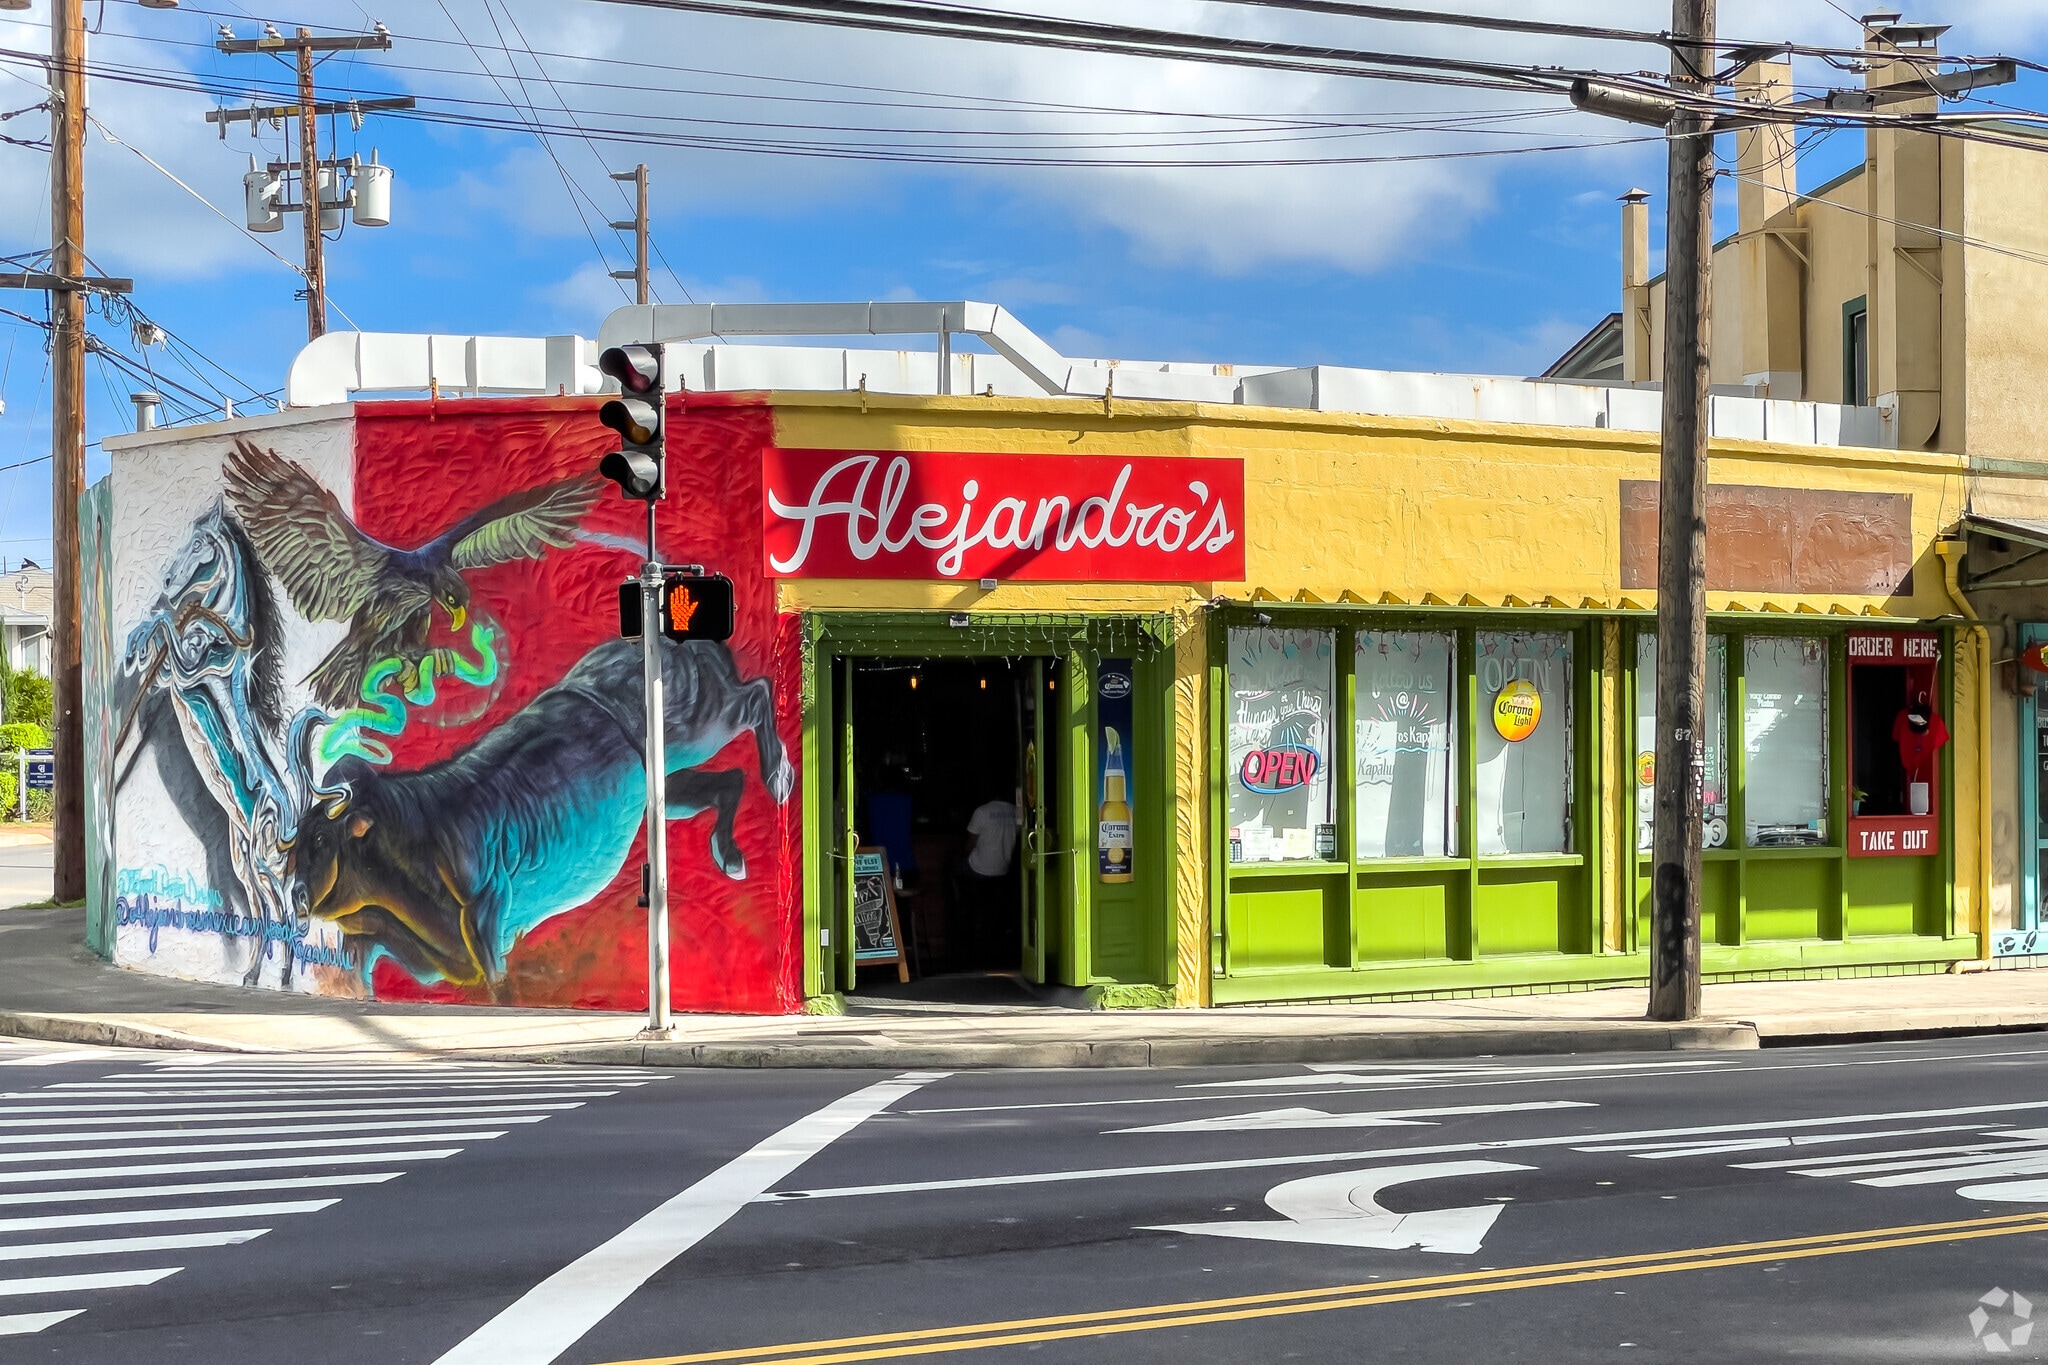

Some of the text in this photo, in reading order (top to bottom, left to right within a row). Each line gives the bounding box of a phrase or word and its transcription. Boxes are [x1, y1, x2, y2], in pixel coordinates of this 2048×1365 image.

[768, 455, 1235, 576] Alejandro's
[1849, 637, 1938, 658] ORDER HERE
[1498, 700, 1534, 717] Corona
[1514, 714, 1532, 726] Light
[1674, 728, 1692, 741] 67
[1244, 750, 1315, 785] OPEN
[1101, 822, 1130, 833] Corona
[1860, 830, 1929, 850] TAKE OUT
